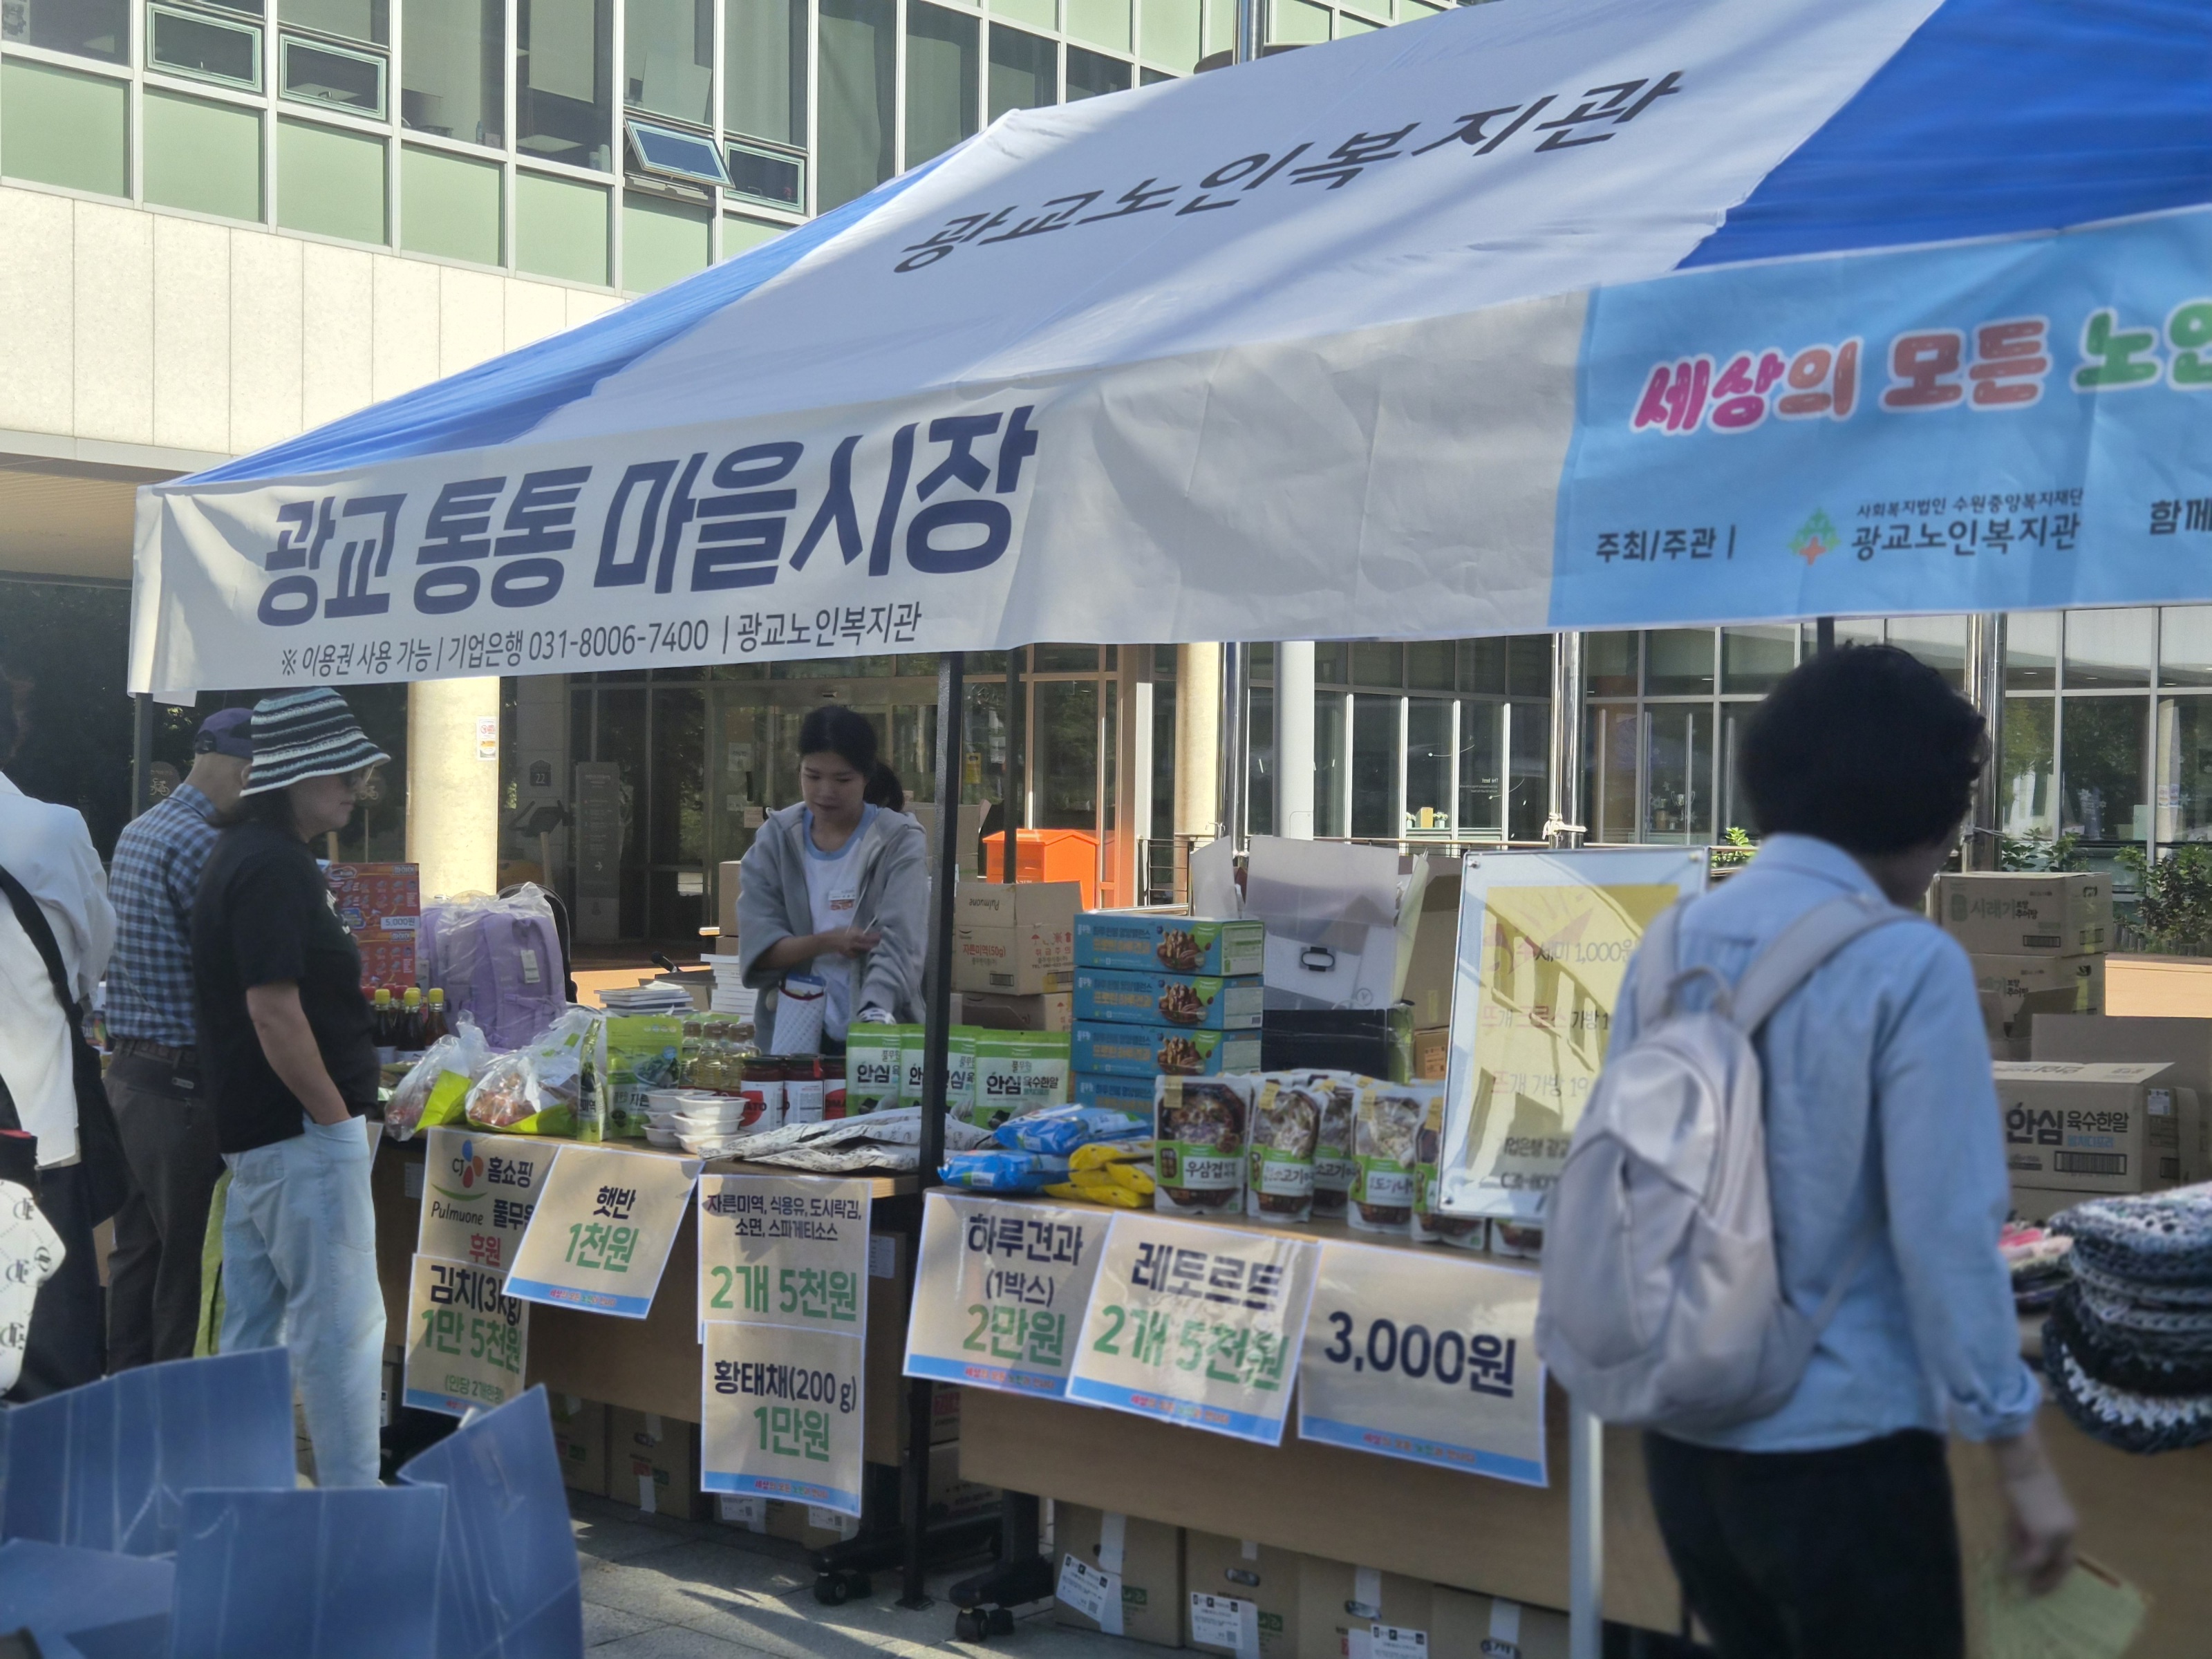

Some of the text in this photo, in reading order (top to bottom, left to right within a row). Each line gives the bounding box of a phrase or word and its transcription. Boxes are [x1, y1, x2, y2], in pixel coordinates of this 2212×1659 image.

[893, 72, 1683, 274] 광교노인복지관
[1632, 338, 1862, 433] 세상의
[1882, 317, 2050, 412] 모든
[257, 405, 1039, 626] 광교 통통 마을시장
[1857, 487, 2084, 518] 사회복지법인 수원중앙복지재단
[1851, 512, 2082, 561] 광교노인복지관
[302, 643, 354, 677] 이용권
[357, 640, 392, 675] 사용
[397, 637, 432, 673] 가능
[448, 629, 523, 669] 기업은행
[529, 619, 709, 661] 031-8006-7400
[738, 601, 922, 653] 광교노인복지관
[969, 898, 1000, 910] Pulmuone
[857, 1062, 890, 1084] 안심
[986, 1072, 1021, 1096] 안심
[2006, 1102, 2130, 1146] 안심 육수한알
[452, 1158, 465, 1176] CJ
[488, 1157, 534, 1188] 홈쇼핑
[1185, 1161, 1224, 1179] 우삼겹
[431, 1201, 484, 1226] Pulmuone
[593, 1185, 637, 1219] 햇반
[707, 1194, 861, 1220] 자른미역, 식용유, 도시락김,
[469, 1233, 501, 1267] 후원
[565, 1224, 639, 1273] 1천원
[735, 1218, 838, 1241] 소면, 스파게티소스
[968, 1213, 1083, 1266] 하루견과
[711, 1265, 857, 1322] 2개 5천원
[986, 1268, 1055, 1308] (1박스)
[1131, 1242, 1284, 1311] 레토르트
[422, 1309, 522, 1374] 1만 5천원
[963, 1304, 1066, 1367] 2만원
[1092, 1304, 1290, 1391] 2개 5천원
[1324, 1311, 1516, 1399] 3,000원
[753, 1405, 830, 1463] 1만원
